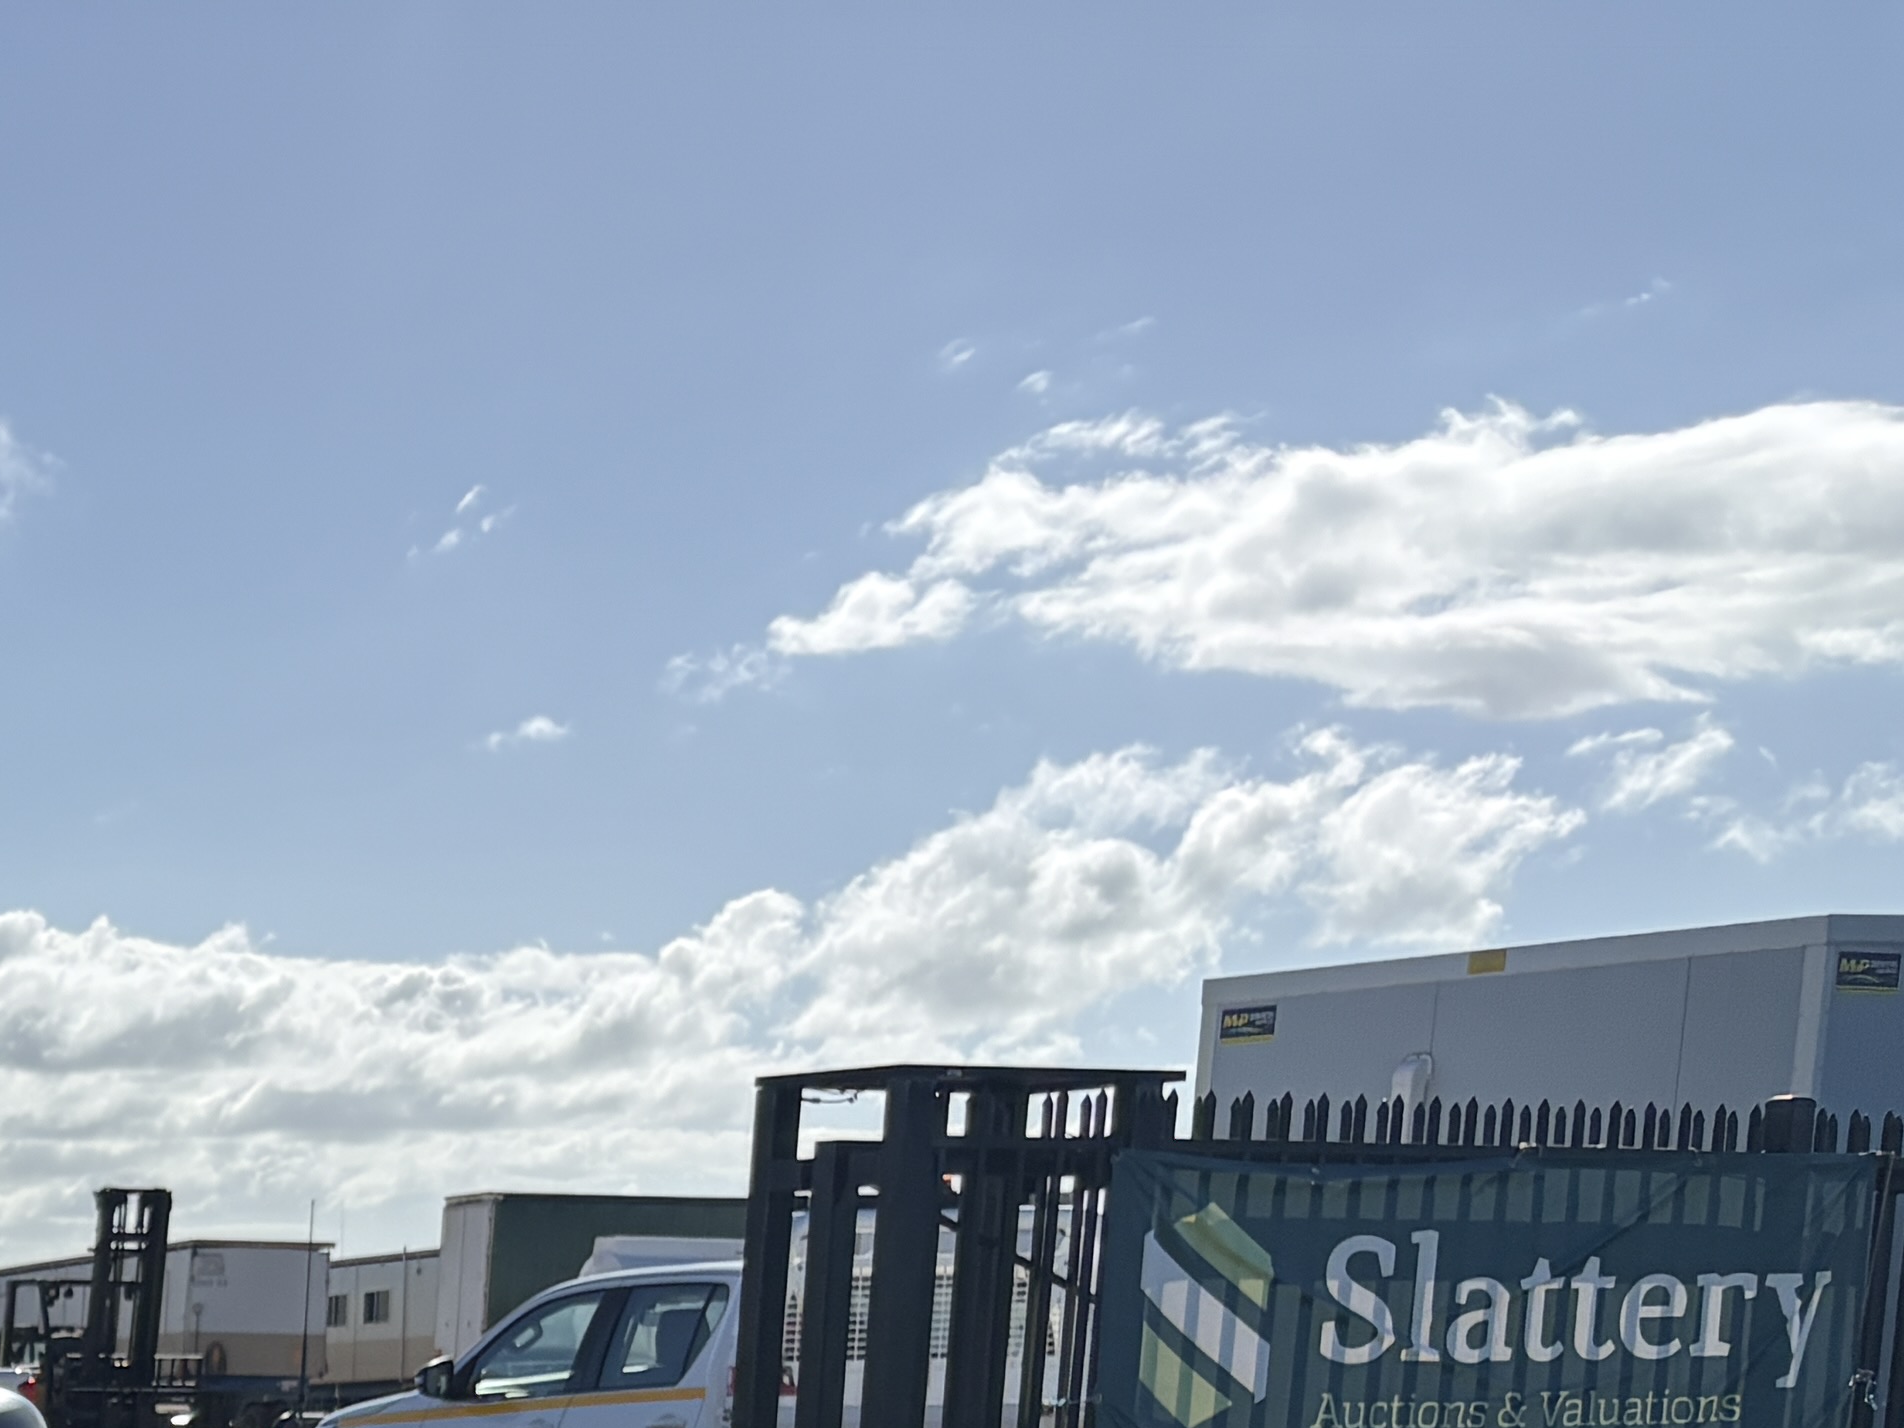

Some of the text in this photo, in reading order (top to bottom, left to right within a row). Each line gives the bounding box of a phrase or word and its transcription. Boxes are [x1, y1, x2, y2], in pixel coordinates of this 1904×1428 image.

[1319, 1229, 1832, 1388] Slattery
[1496, 1390, 1528, 1428] &
[1538, 1387, 1743, 1428] Valuations
